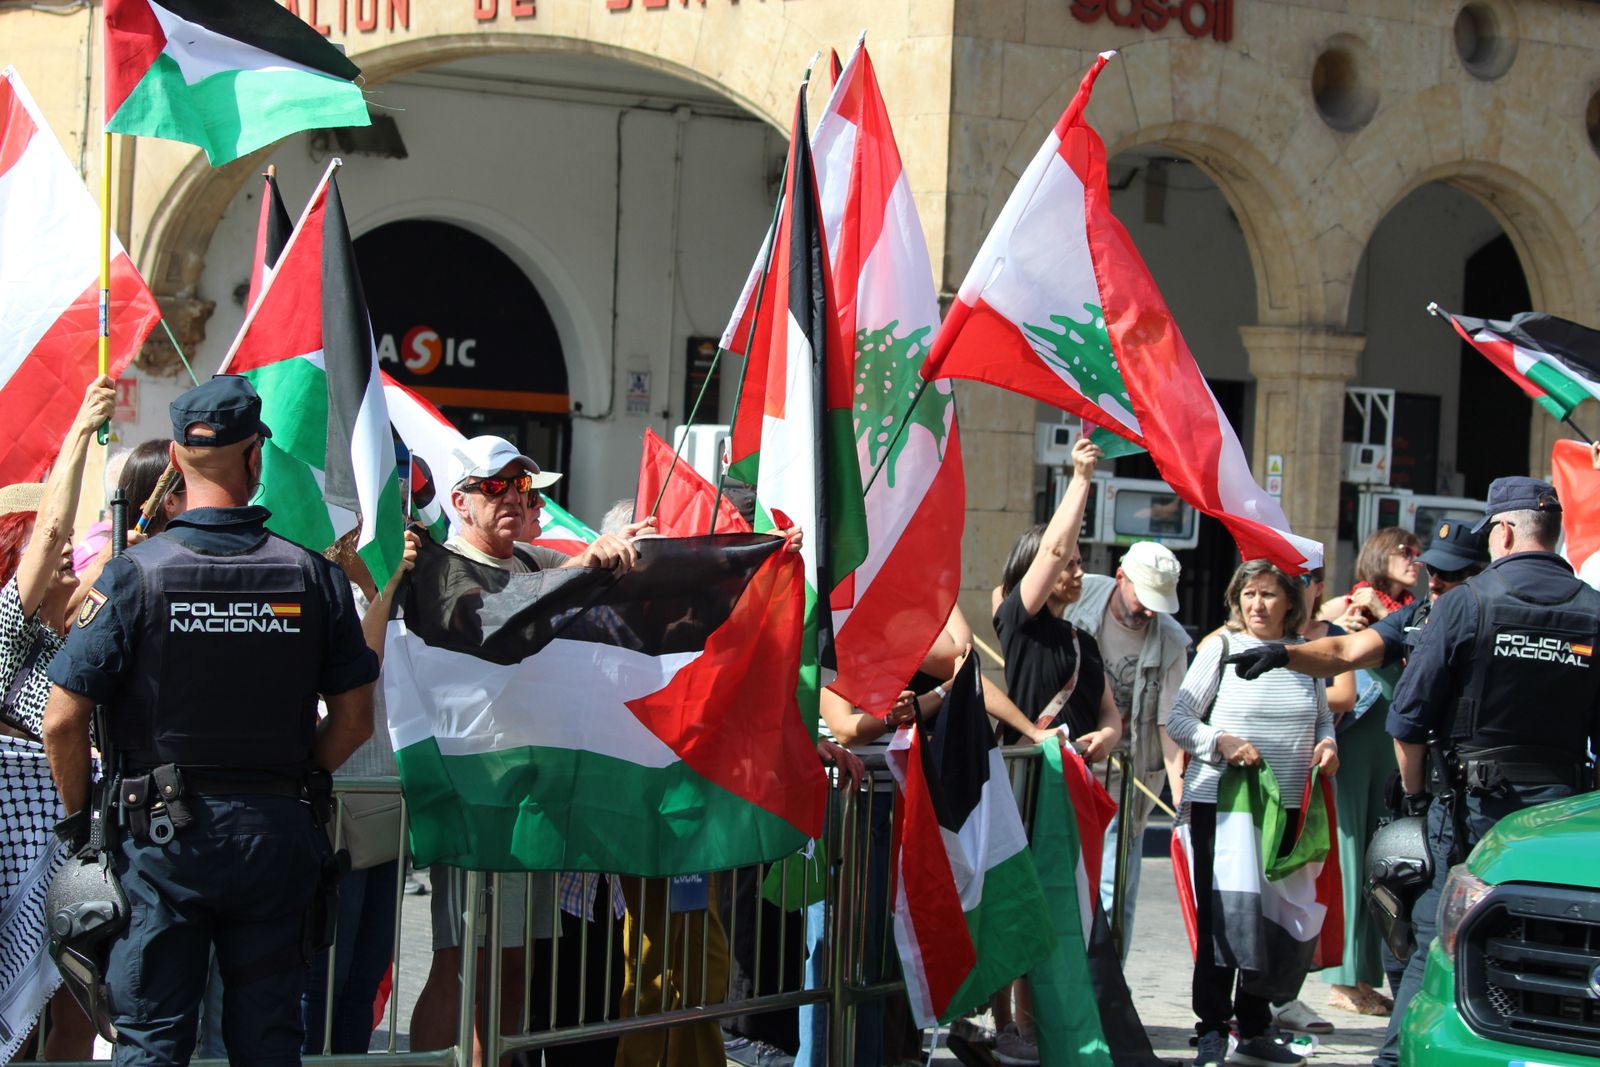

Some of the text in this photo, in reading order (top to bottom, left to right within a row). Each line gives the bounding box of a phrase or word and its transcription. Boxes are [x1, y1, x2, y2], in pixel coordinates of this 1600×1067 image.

[170, 602, 275, 617] POLICIA
[170, 618, 300, 633] NACIONAL
[1496, 633, 1573, 653] POLICIA
[1493, 645, 1590, 668] NACIONAL
